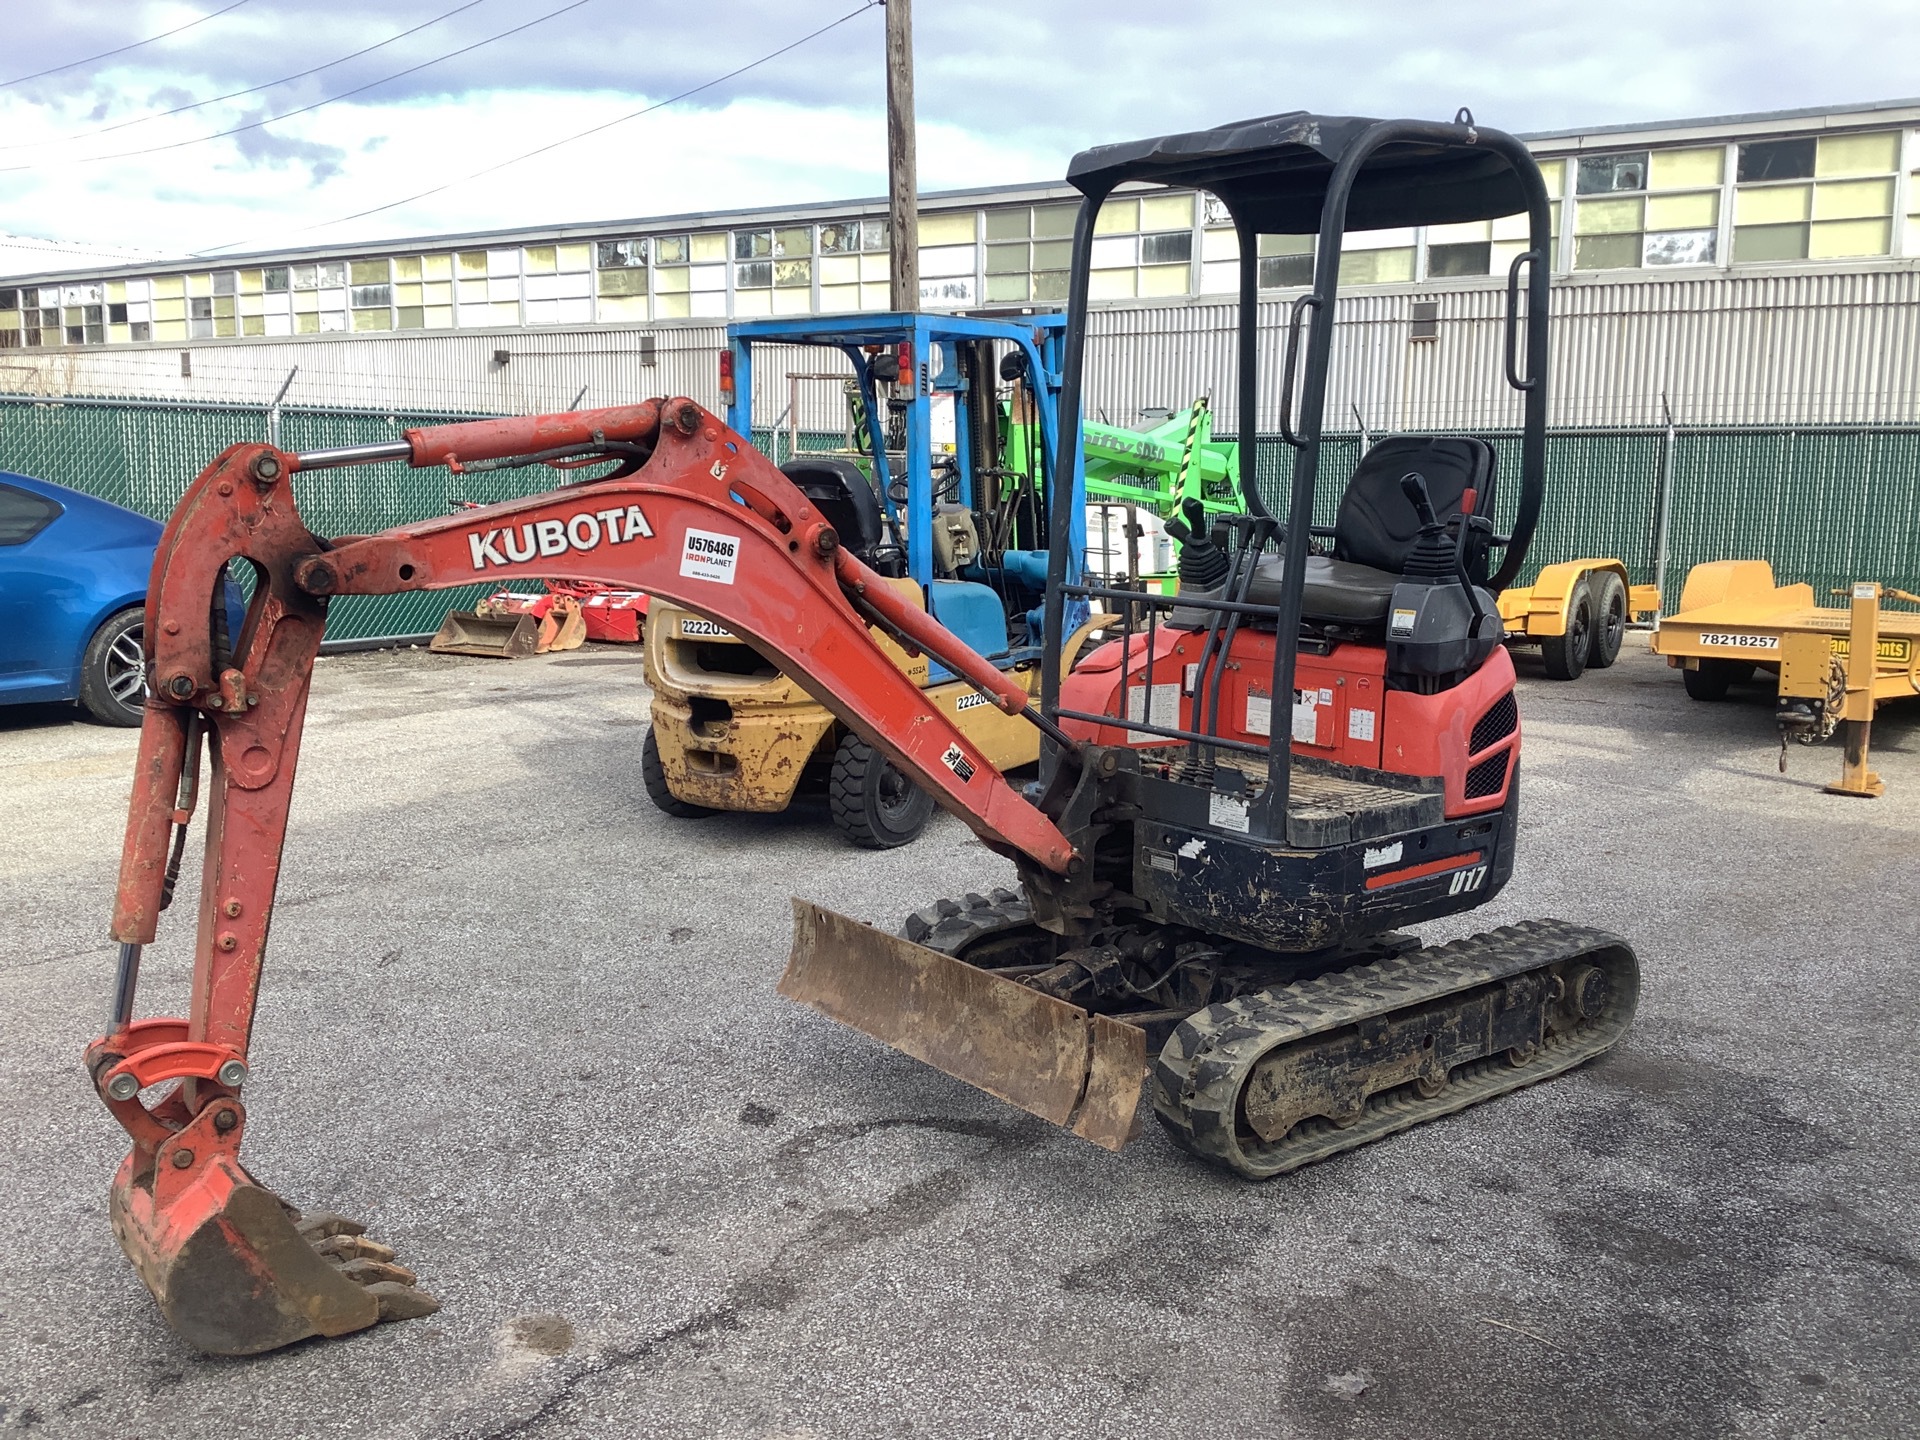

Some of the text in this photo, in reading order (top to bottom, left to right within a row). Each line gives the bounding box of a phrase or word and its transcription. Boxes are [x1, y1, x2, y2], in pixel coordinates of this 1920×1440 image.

[468, 505, 654, 569] KUBOTA
[688, 536, 735, 557] U576486
[682, 620, 730, 636] 22220
[1701, 634, 1778, 648] 78218257
[1449, 865, 1488, 895] U17
